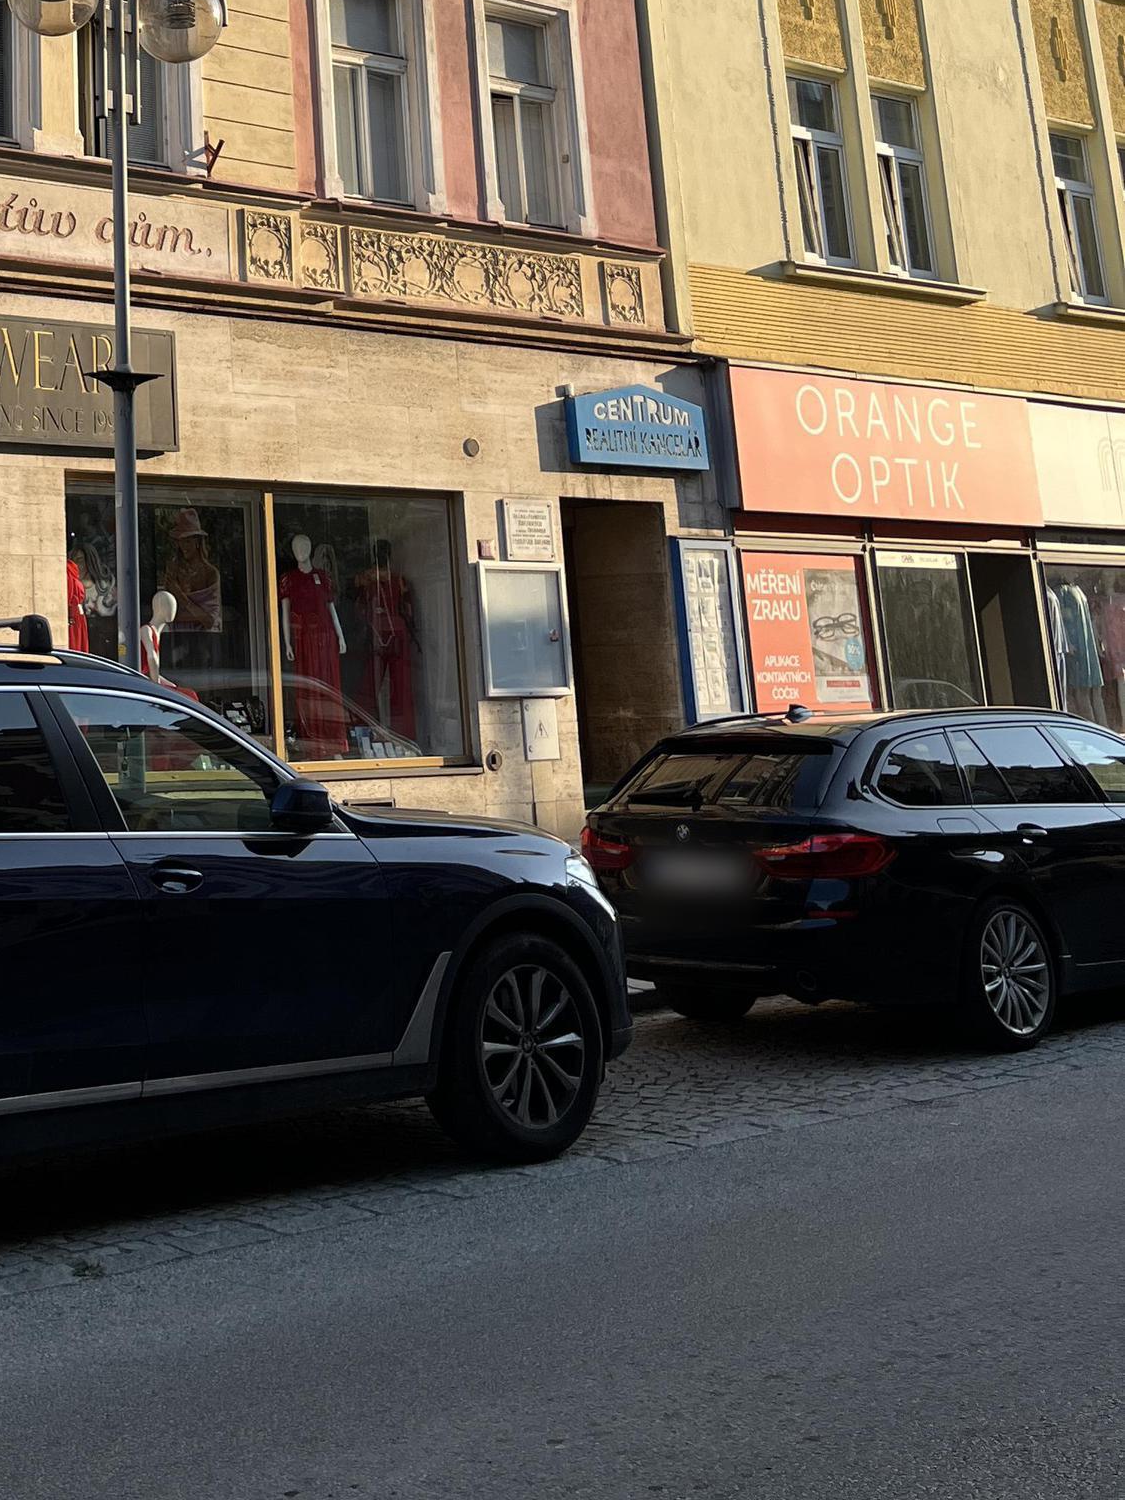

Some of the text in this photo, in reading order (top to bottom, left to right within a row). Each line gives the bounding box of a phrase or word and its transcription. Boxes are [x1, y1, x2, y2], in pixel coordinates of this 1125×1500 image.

[32, 403, 84, 434] SINCE
[593, 394, 691, 426] CENTRUM
[795, 384, 982, 449] ORANGE
[584, 425, 703, 458] REALITNÍ KANCELÁŘ
[831, 452, 966, 510] OPTIK
[746, 568, 802, 596] MĚŘENÍ
[751, 598, 801, 621] ZRAKU
[763, 654, 801, 667] APLIKACE
[756, 668, 812, 684] KONTAKTNÍCH
[770, 684, 801, 700] ČOČEK
